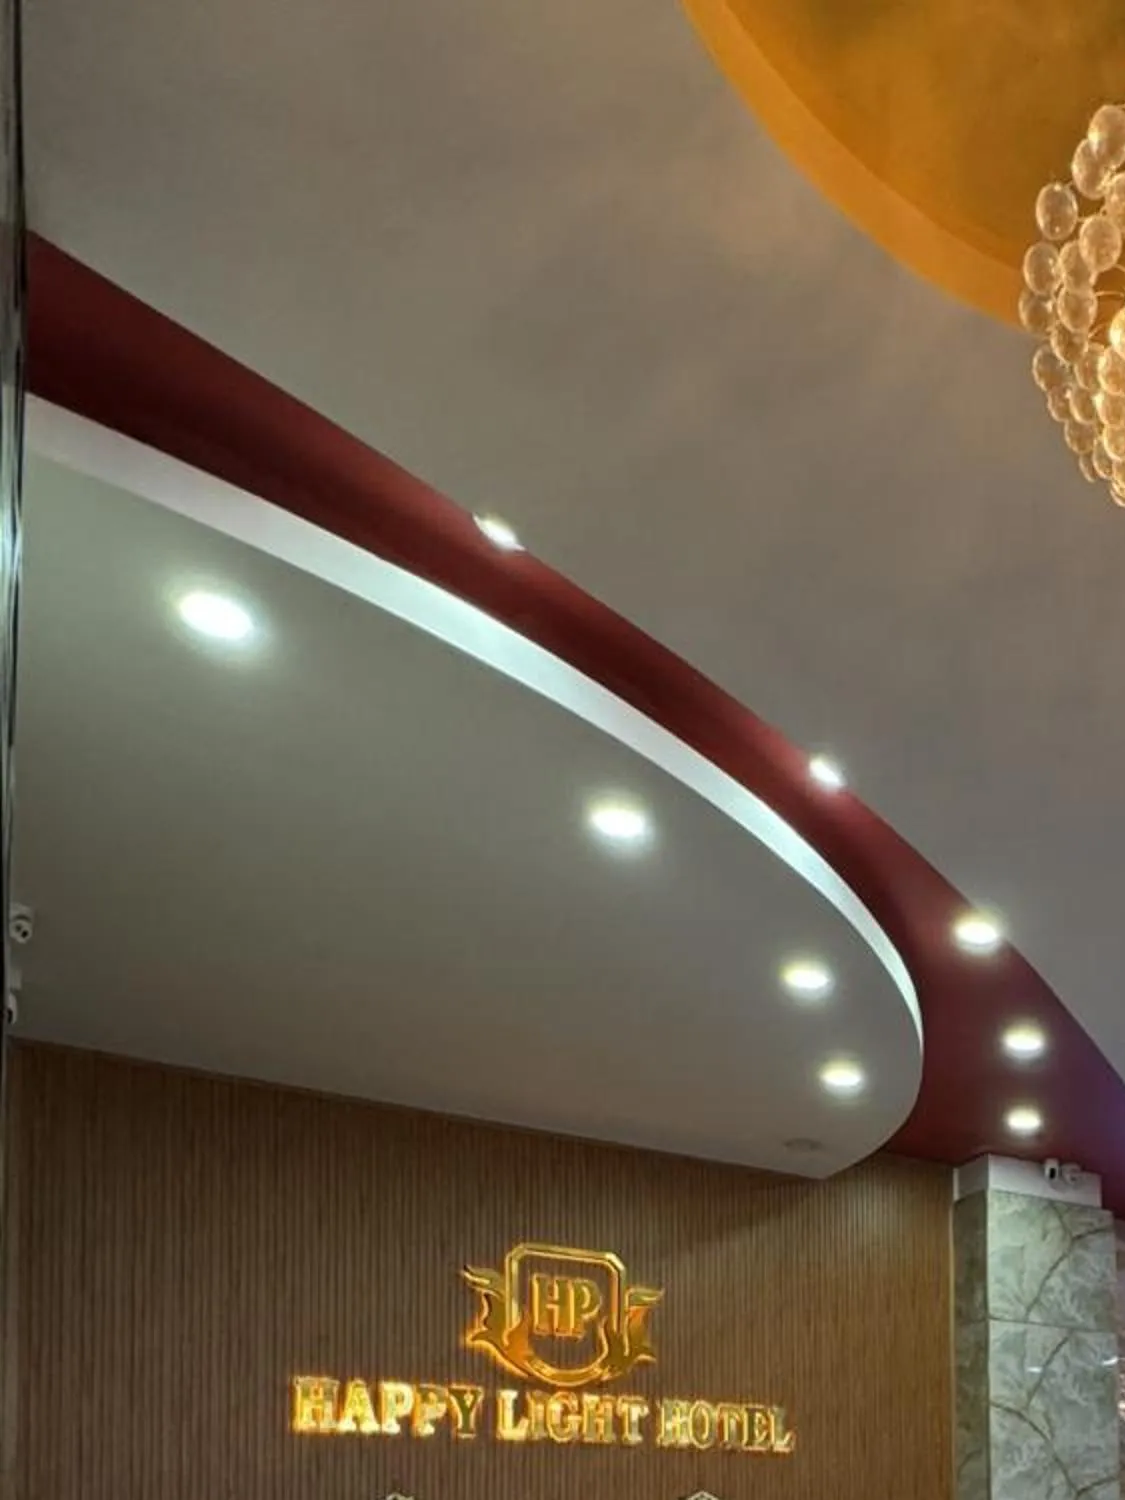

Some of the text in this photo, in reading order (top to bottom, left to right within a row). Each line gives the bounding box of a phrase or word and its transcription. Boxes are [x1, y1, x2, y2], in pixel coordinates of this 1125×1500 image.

[531, 1274, 602, 1338] HP
[292, 1375, 797, 1453] HAPPY LIGHT HOTEL
